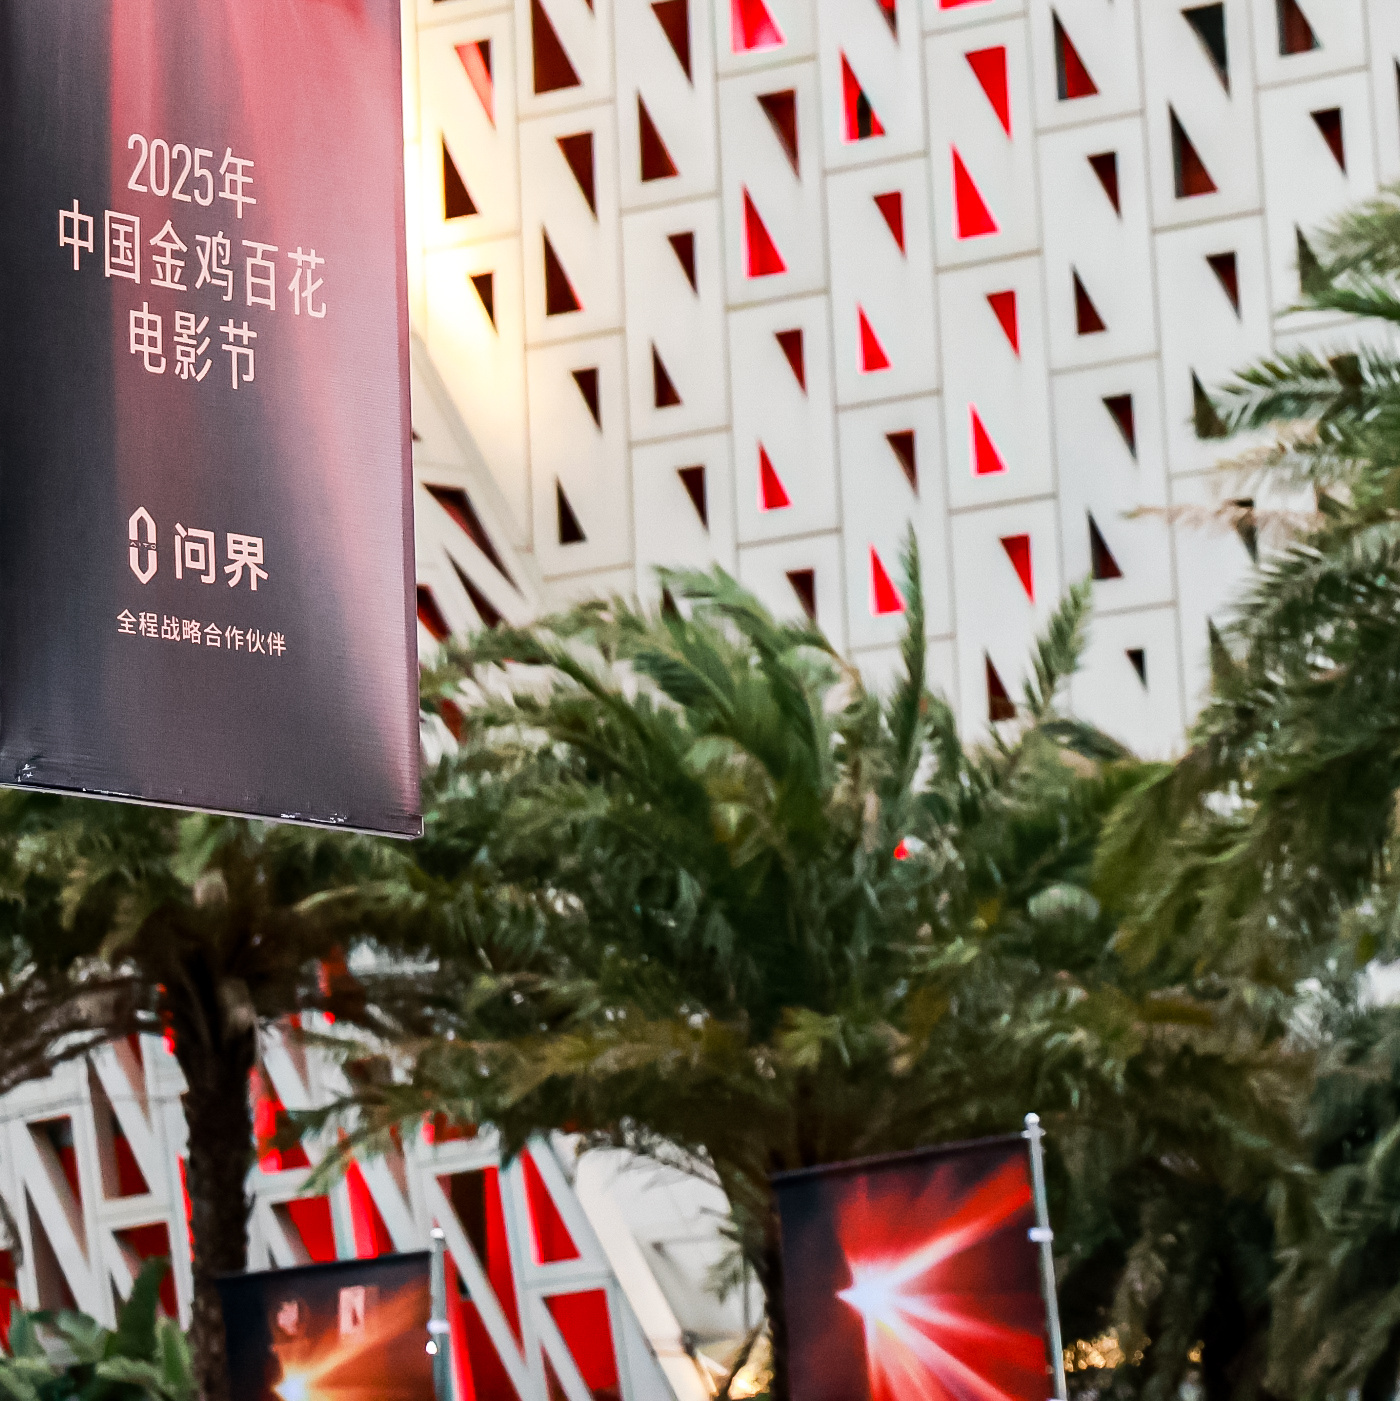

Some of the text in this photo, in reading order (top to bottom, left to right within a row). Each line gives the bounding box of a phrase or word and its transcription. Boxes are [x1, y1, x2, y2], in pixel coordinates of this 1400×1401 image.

[127, 133, 257, 219] 2025年
[58, 199, 327, 318] 中国金鸡百花
[128, 302, 257, 389] 电影节
[174, 522, 269, 591] 问界
[116, 608, 287, 657] 全程战略合作伙伴
